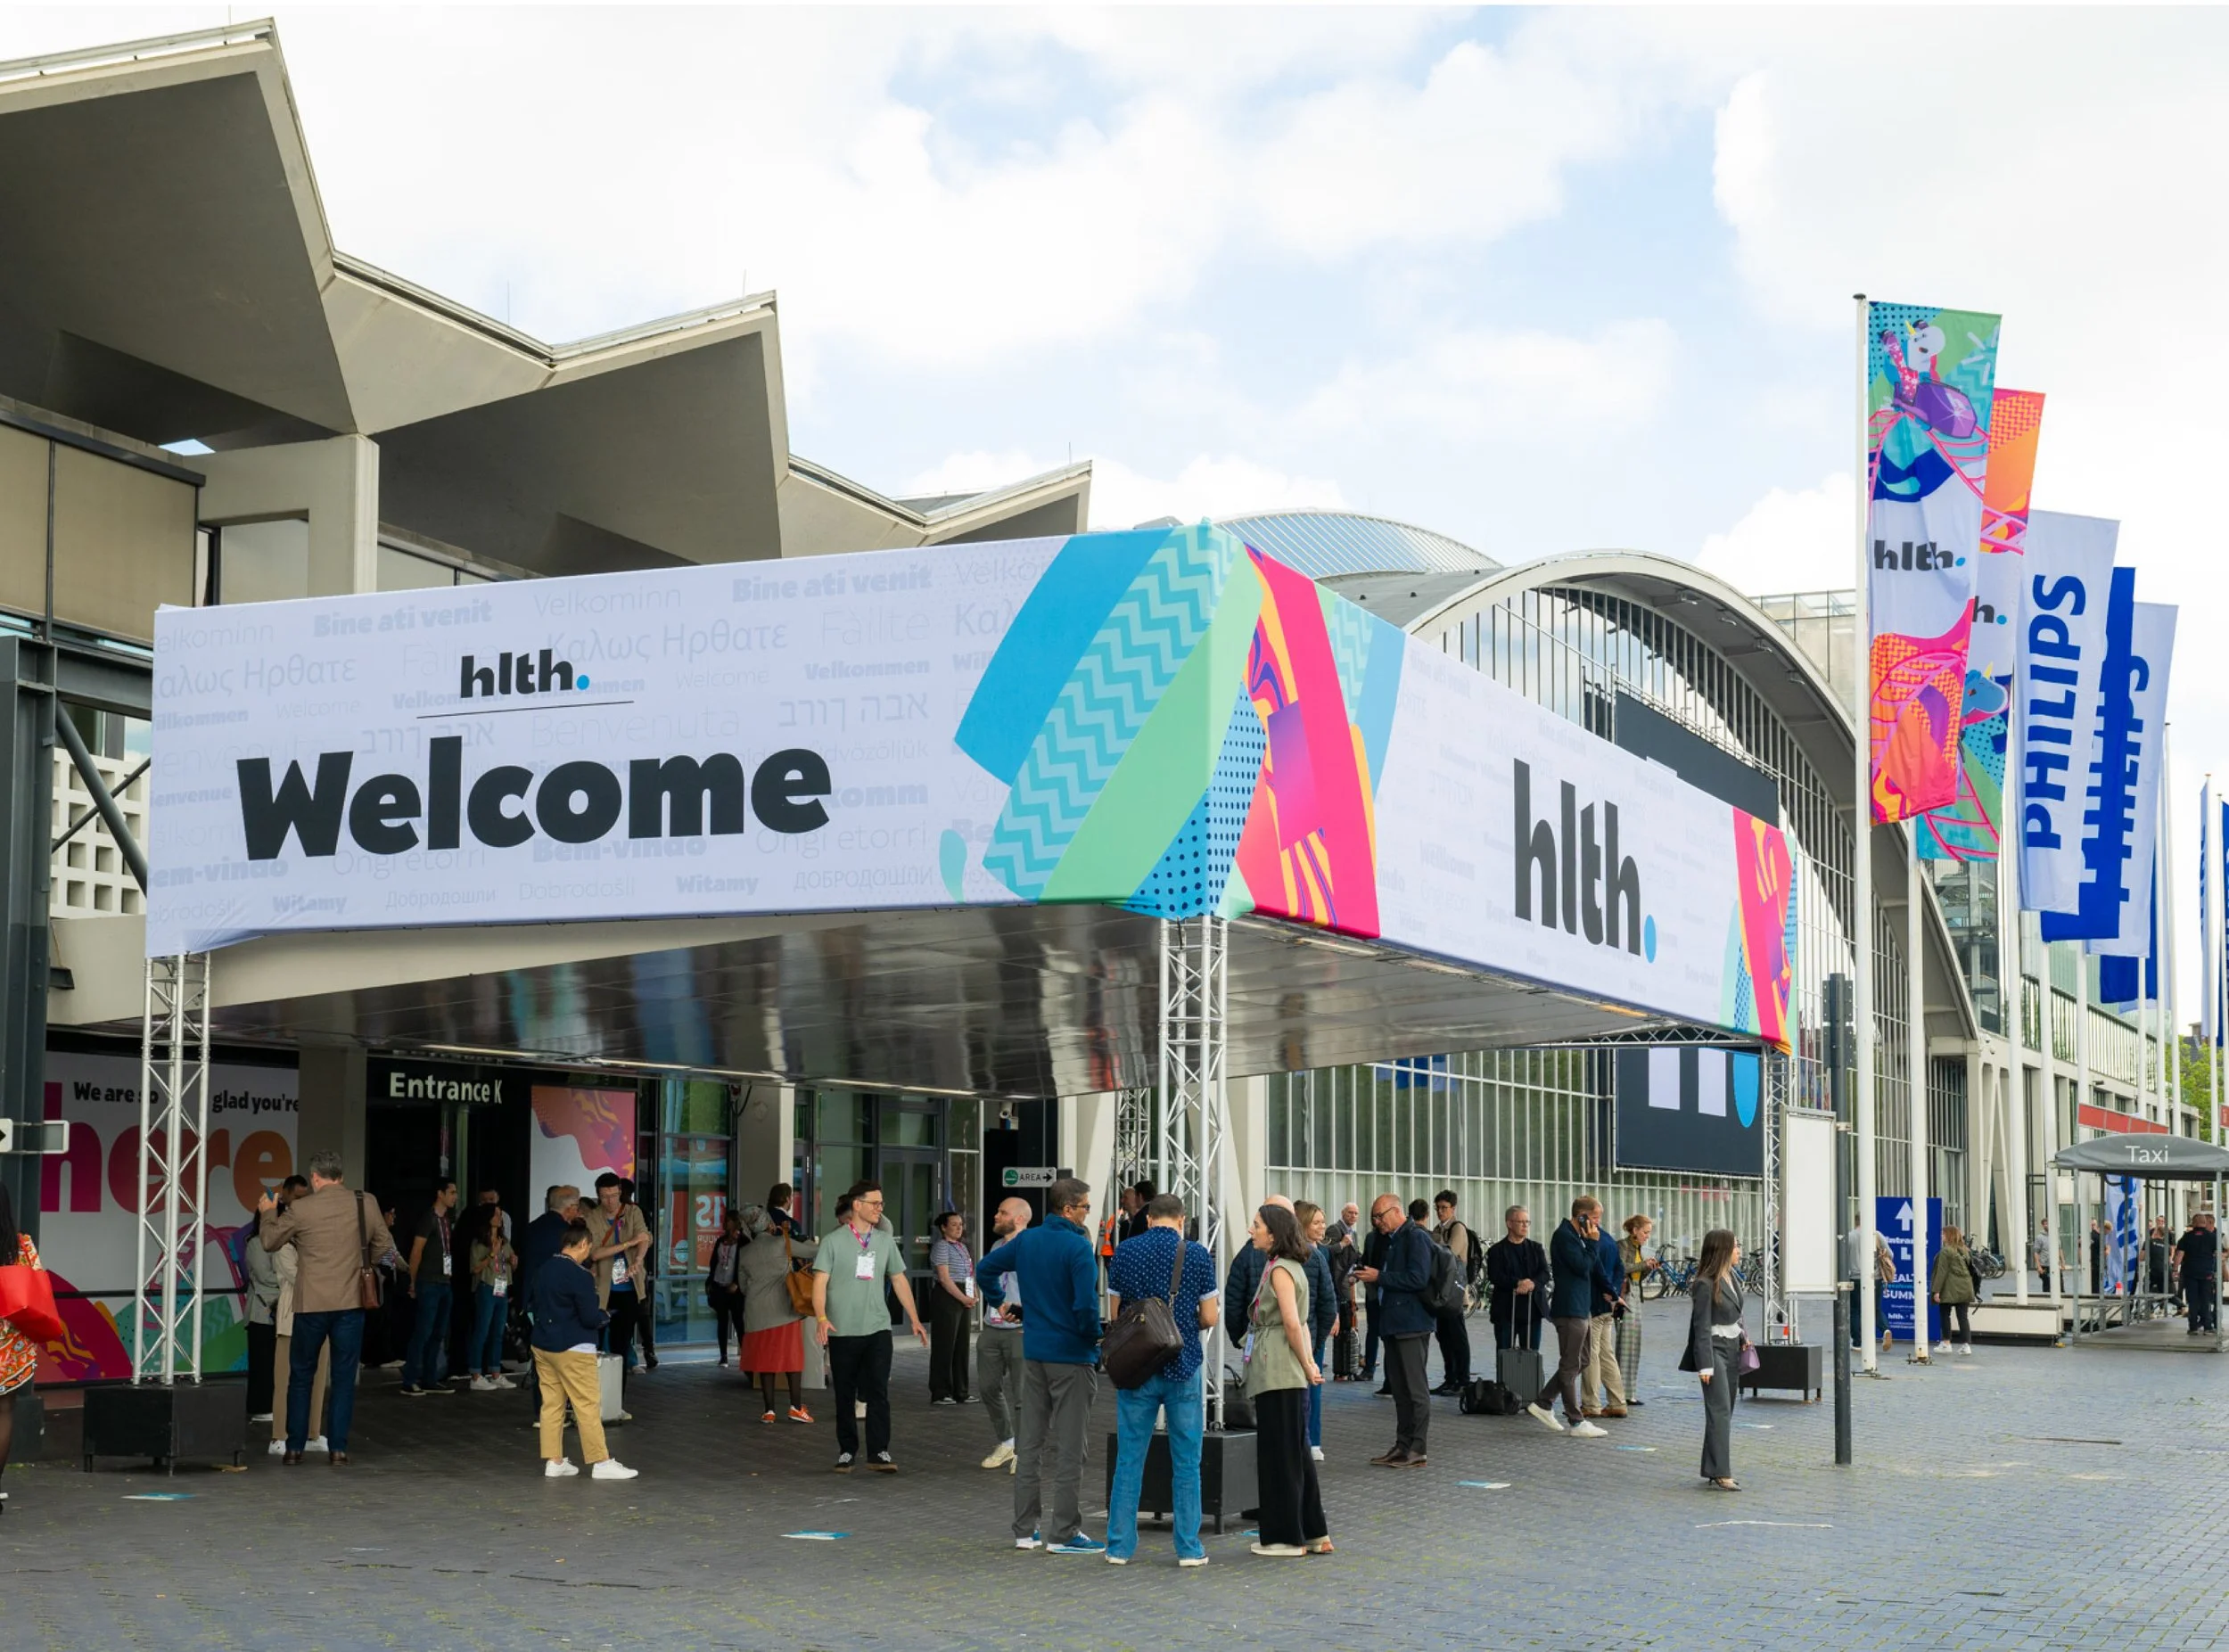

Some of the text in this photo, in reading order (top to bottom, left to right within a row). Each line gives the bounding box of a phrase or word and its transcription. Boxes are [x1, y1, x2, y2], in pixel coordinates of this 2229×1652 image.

[1874, 539, 1966, 571] hlth.
[732, 565, 933, 603] Bine ati venit
[313, 598, 493, 638] Bine ati venit
[533, 586, 681, 618] Velkominn
[155, 619, 275, 654] elkominn
[155, 663, 234, 699] αλως
[460, 649, 590, 699] hlth.
[675, 667, 770, 689] Welcome
[804, 660, 930, 680] Velkommen
[2025, 574, 2086, 851] PHILIPS
[150, 786, 233, 808] ienvenue
[236, 736, 832, 861] Welcome
[1514, 757, 1657, 964] hlth.
[676, 875, 759, 896] Witamy
[74, 1081, 102, 1102] We
[104, 1087, 134, 1103] are
[211, 1090, 249, 1113] glad
[390, 1072, 502, 1105] Entrance K
[2126, 1145, 2169, 1163] Taxi
[1020, 1173, 1041, 1181] AREA
[1901, 1246, 1912, 1261] L
